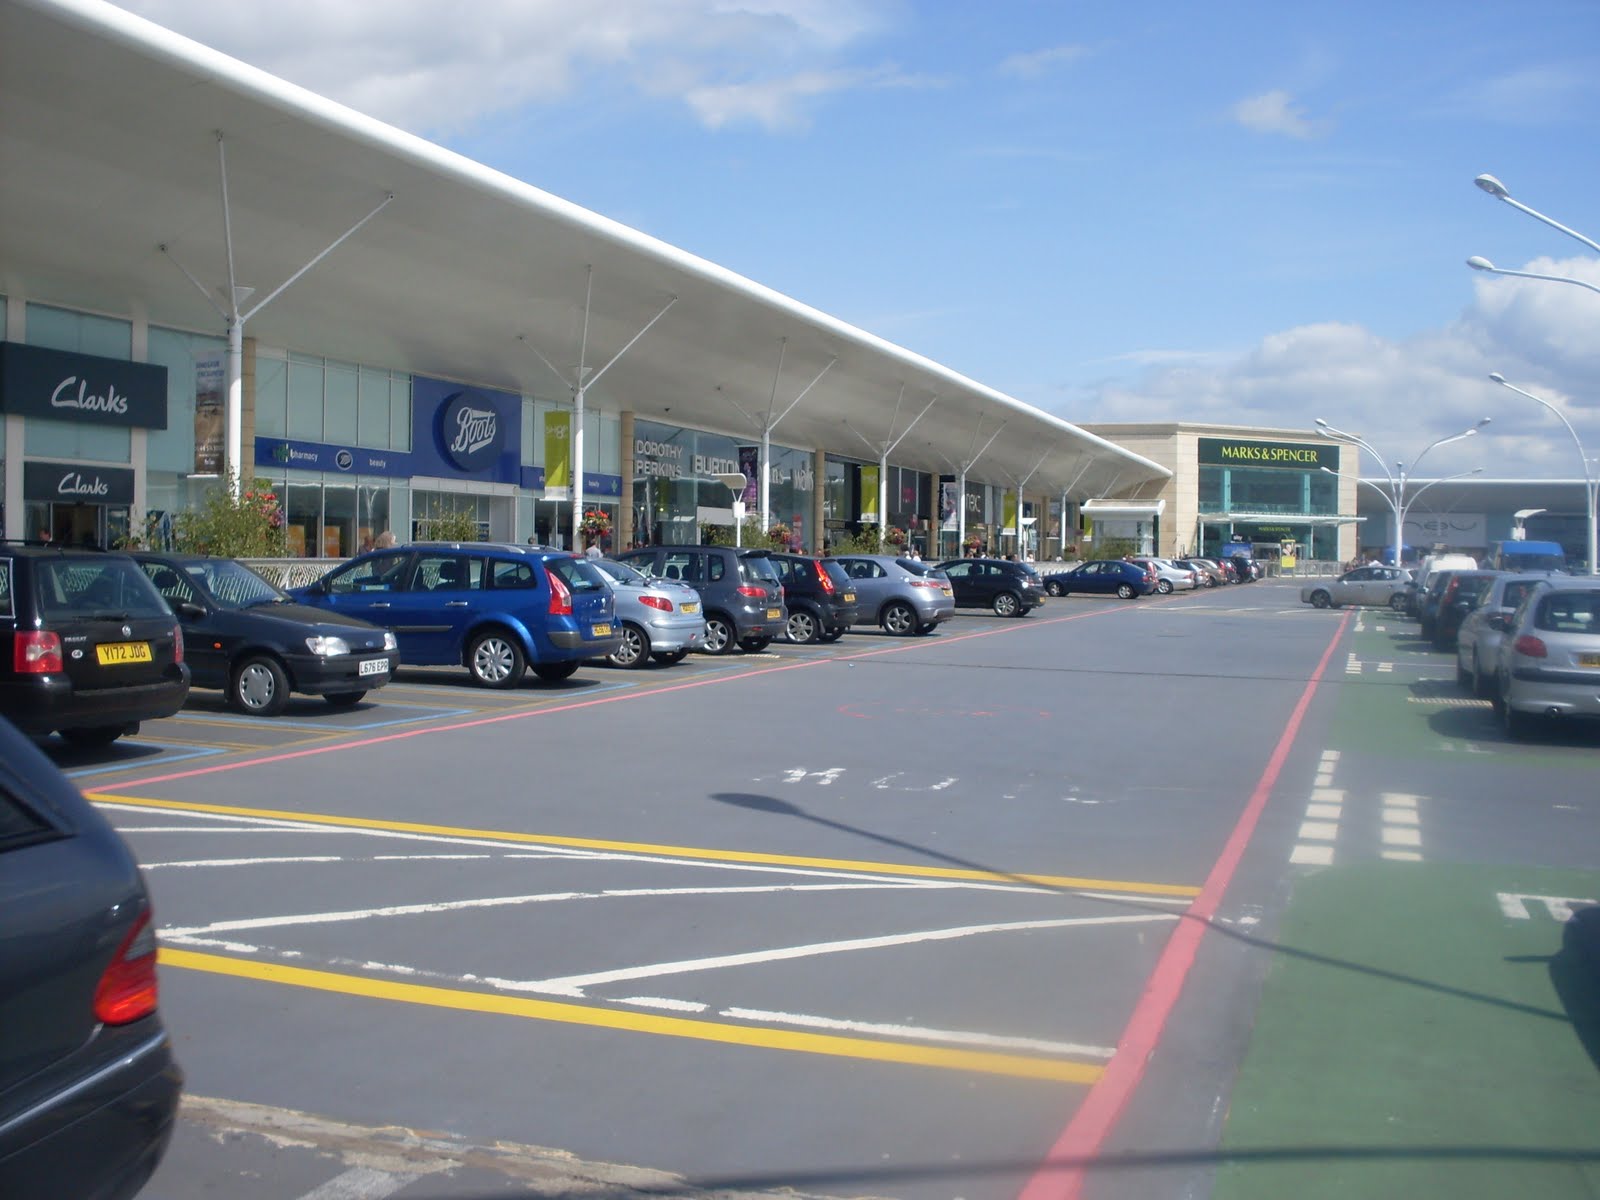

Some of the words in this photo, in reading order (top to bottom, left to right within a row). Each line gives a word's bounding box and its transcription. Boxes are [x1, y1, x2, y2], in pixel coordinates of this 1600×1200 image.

[51, 376, 128, 414] Clarks
[451, 406, 497, 455] Boots
[290, 449, 318, 462] pharmacy
[636, 440, 683, 459] DOROTHY
[1222, 446, 1260, 460] MARKS
[1261, 448, 1270, 460] &
[1271, 448, 1318, 463] SPENCER
[636, 460, 682, 477] PERKINS
[58, 472, 108, 495] Clarks
